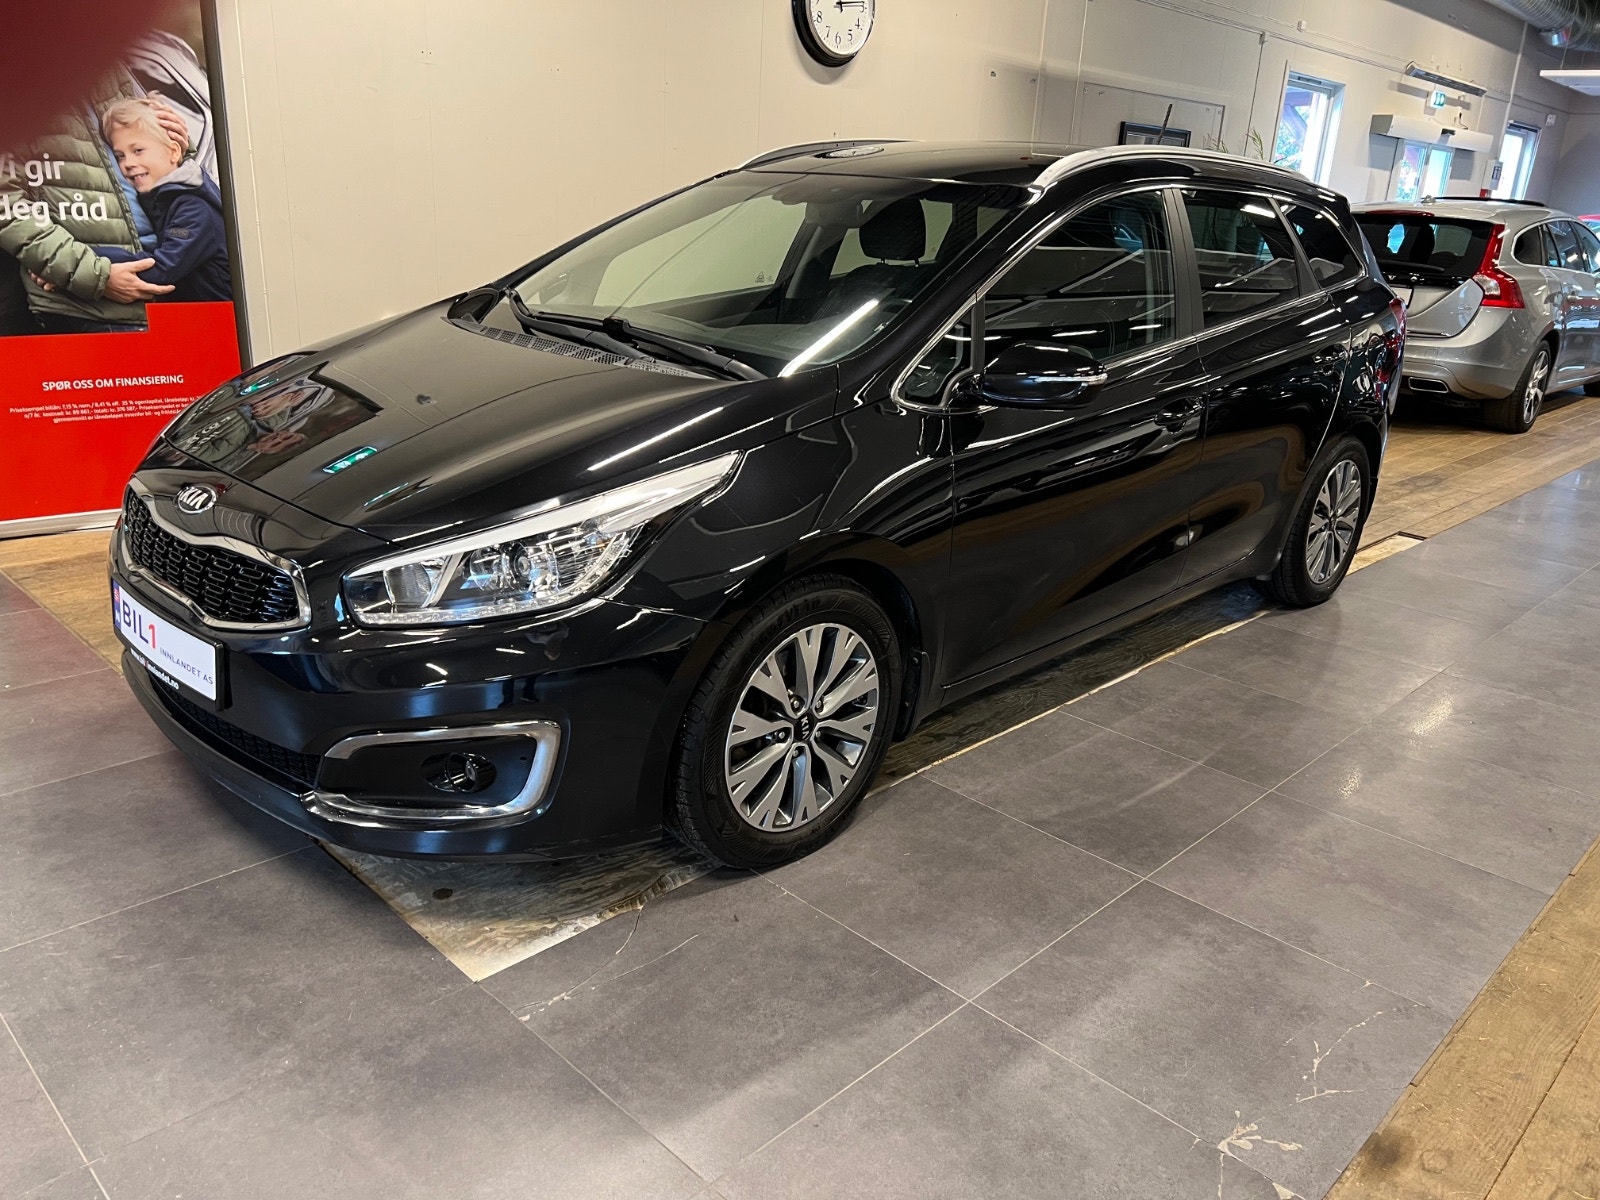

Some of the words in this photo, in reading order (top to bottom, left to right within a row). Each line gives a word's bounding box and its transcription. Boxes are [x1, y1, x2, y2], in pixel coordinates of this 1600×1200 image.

[816, 11, 822, 23] 8
[855, 18, 861, 29] 4
[826, 25, 831, 38] 7
[835, 32, 842, 45] 6
[848, 29, 853, 41] 5
[24, 153, 65, 187] gir
[0, 194, 51, 228] deg
[59, 193, 108, 221] råd
[42, 380, 72, 391] SPØR
[73, 379, 94, 389] OSS
[95, 378, 114, 388] OM
[115, 374, 184, 387] FINANSIERING
[180, 488, 209, 510] KIA
[159, 647, 201, 678] INNLANDET
[203, 673, 214, 685] AS
[800, 715, 810, 740] KIA
